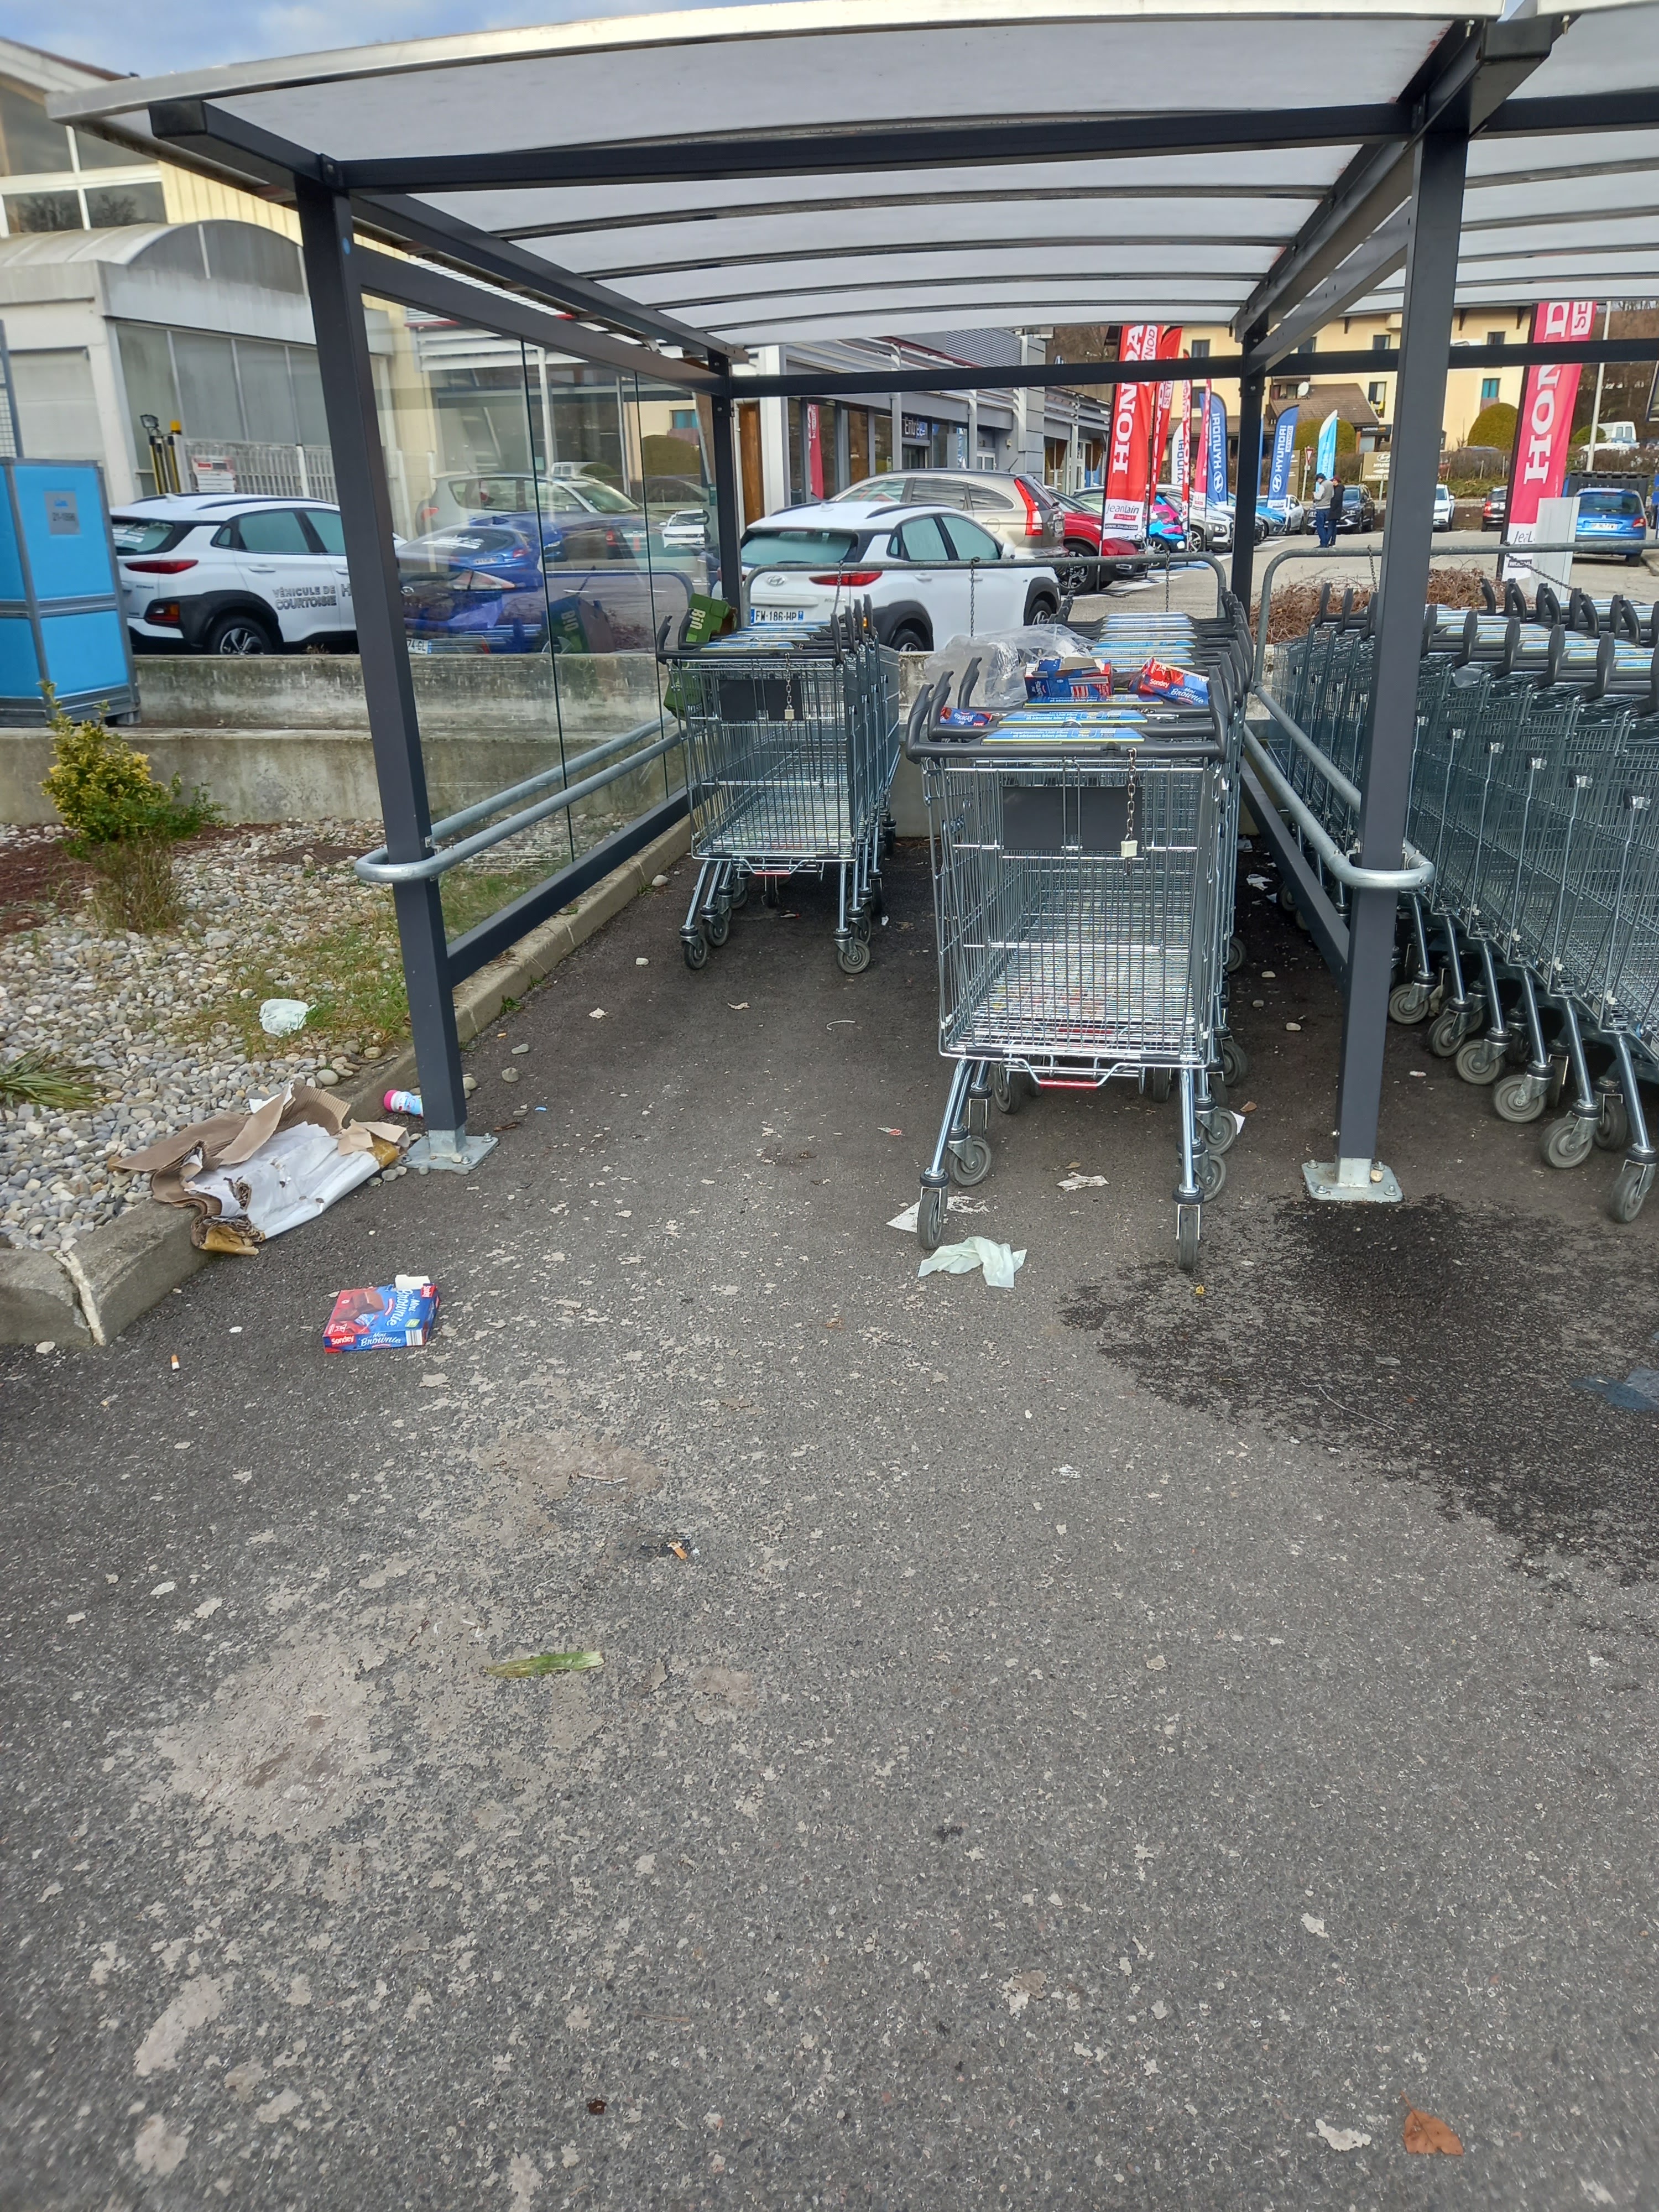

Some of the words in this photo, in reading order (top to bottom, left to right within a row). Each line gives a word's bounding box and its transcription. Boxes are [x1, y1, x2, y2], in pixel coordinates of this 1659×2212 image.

[1523, 302, 1569, 484] HOND
[1275, 425, 1287, 472] HYUNDAI
[323, 585, 336, 594] DE
[1150, 679, 1170, 688] Sondey
[1170, 688, 1204, 704] Brownie
[387, 1289, 414, 1327] Brownie
[331, 1335, 354, 1345] Sondey
[361, 1336, 402, 1347] Brownie
